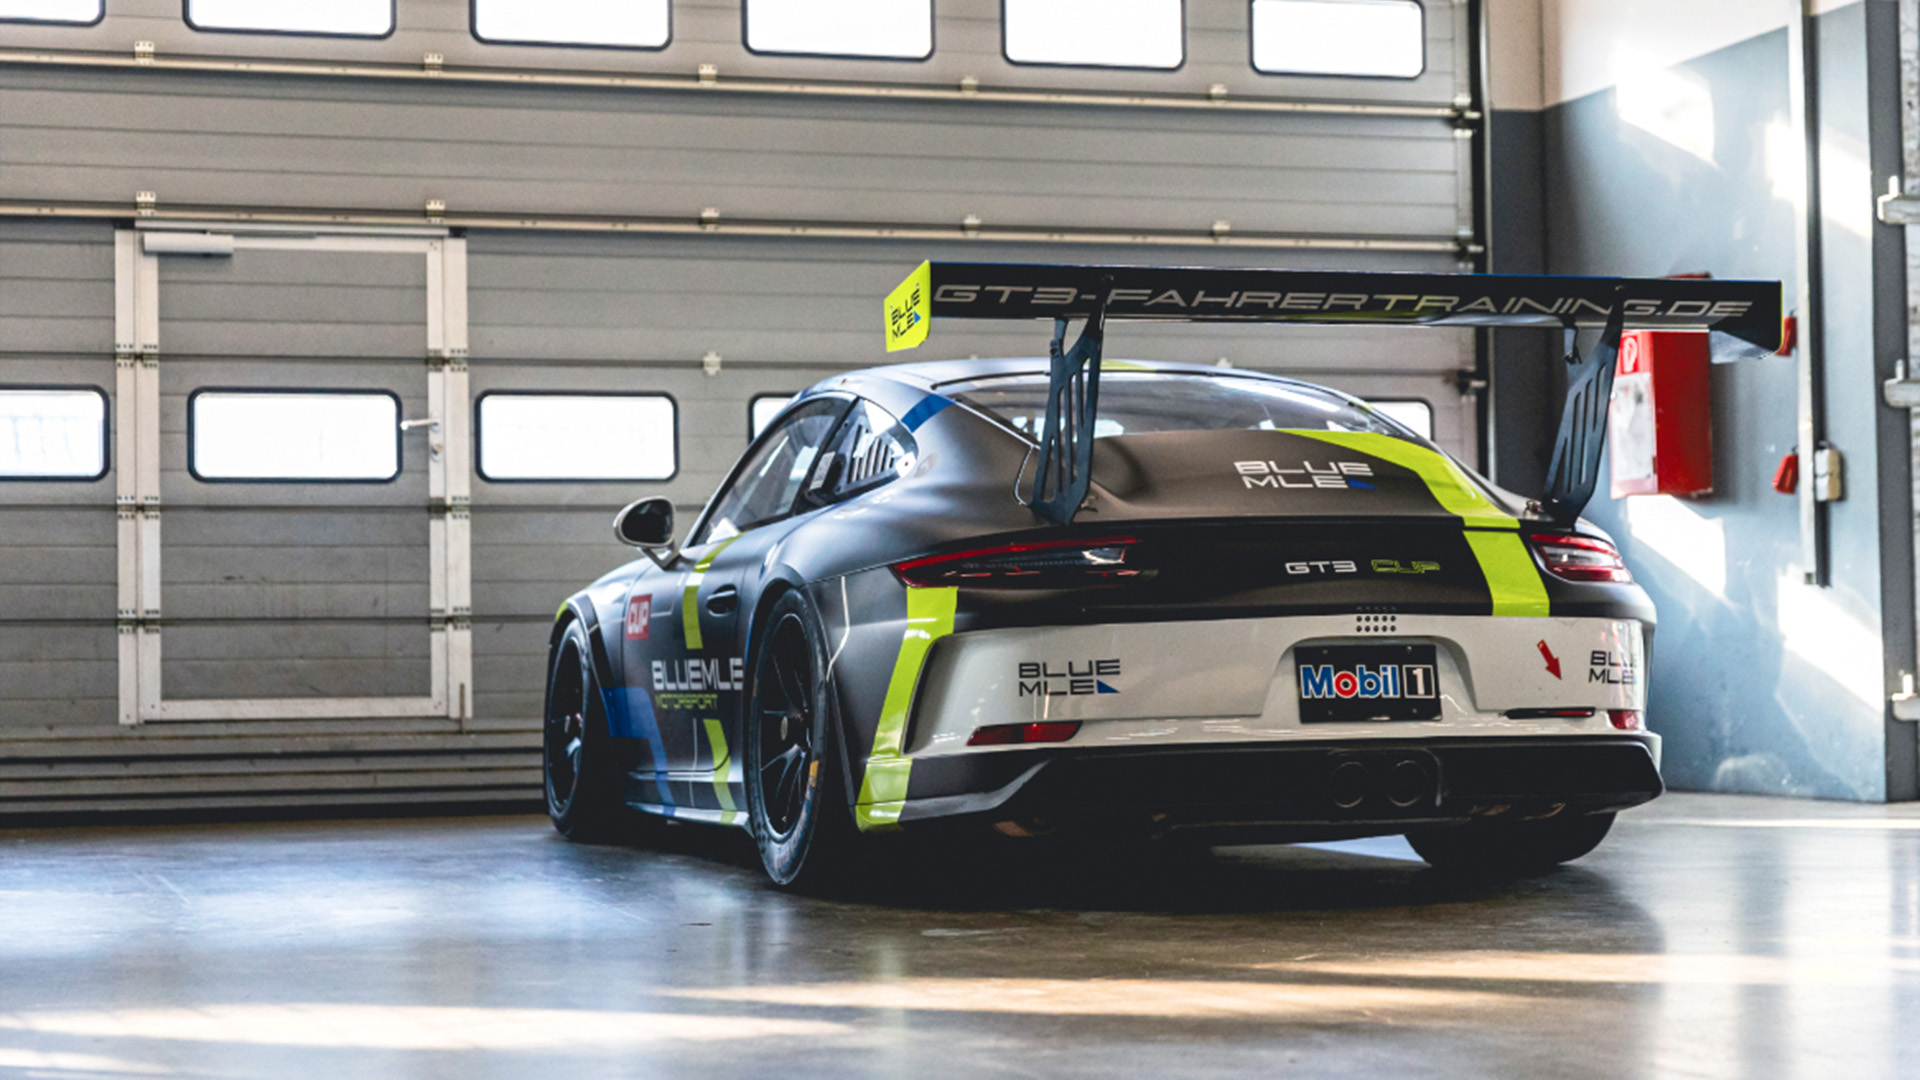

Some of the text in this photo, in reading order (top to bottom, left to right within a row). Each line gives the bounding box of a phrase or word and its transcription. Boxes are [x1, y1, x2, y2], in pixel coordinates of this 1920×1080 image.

[891, 288, 920, 326] BLUE
[892, 311, 915, 343] MLE
[1234, 460, 1374, 477] BLUE
[1241, 474, 1348, 489] MLE
[1285, 559, 1440, 574] GT3 CUP
[627, 600, 650, 635] CUP
[651, 657, 744, 691] BLUEMLE
[1019, 659, 1121, 679] BLUE
[1588, 667, 1634, 685] MLE
[1019, 679, 1094, 697] MLE
[1300, 664, 1401, 699] Mobil
